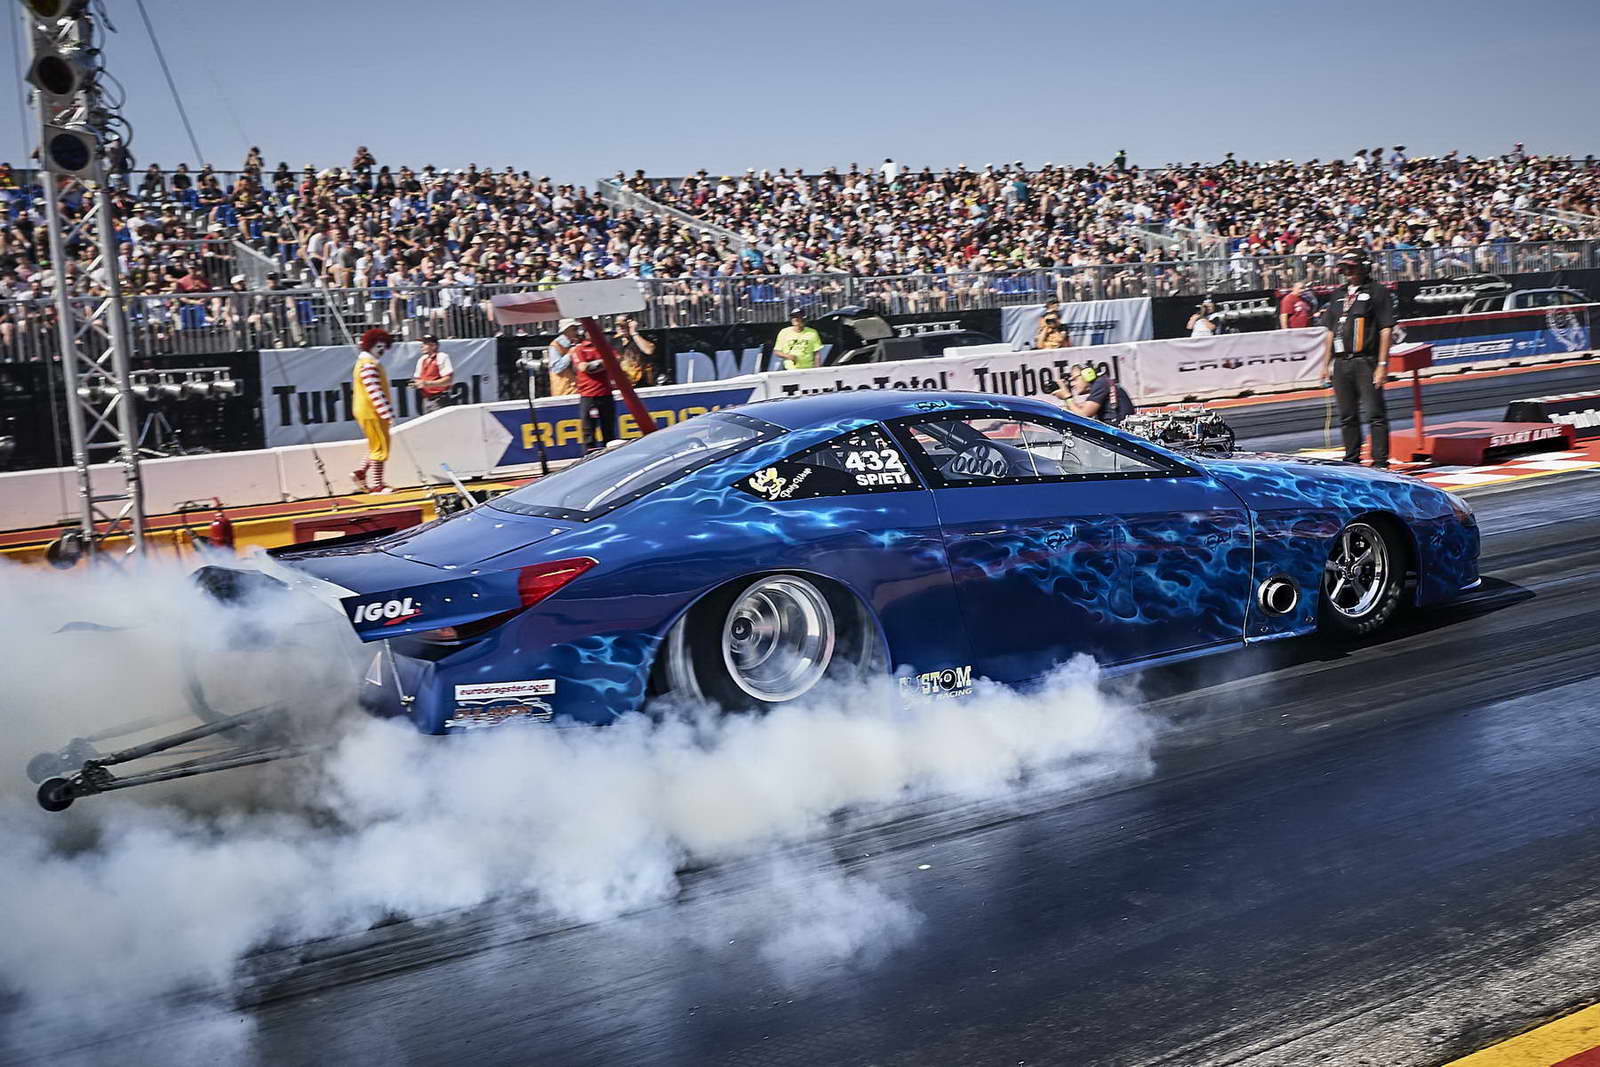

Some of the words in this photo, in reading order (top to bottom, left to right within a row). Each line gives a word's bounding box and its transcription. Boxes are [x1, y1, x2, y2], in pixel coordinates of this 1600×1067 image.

[782, 371, 947, 396] TbTotal
[973, 355, 1119, 397] TurboTal
[272, 374, 482, 427] TurTal
[1489, 431, 1532, 447] START
[1532, 426, 1562, 440] LINE
[845, 449, 903, 471] 432
[353, 597, 416, 623] IGOL
[459, 683, 550, 695] eurodragster.com
